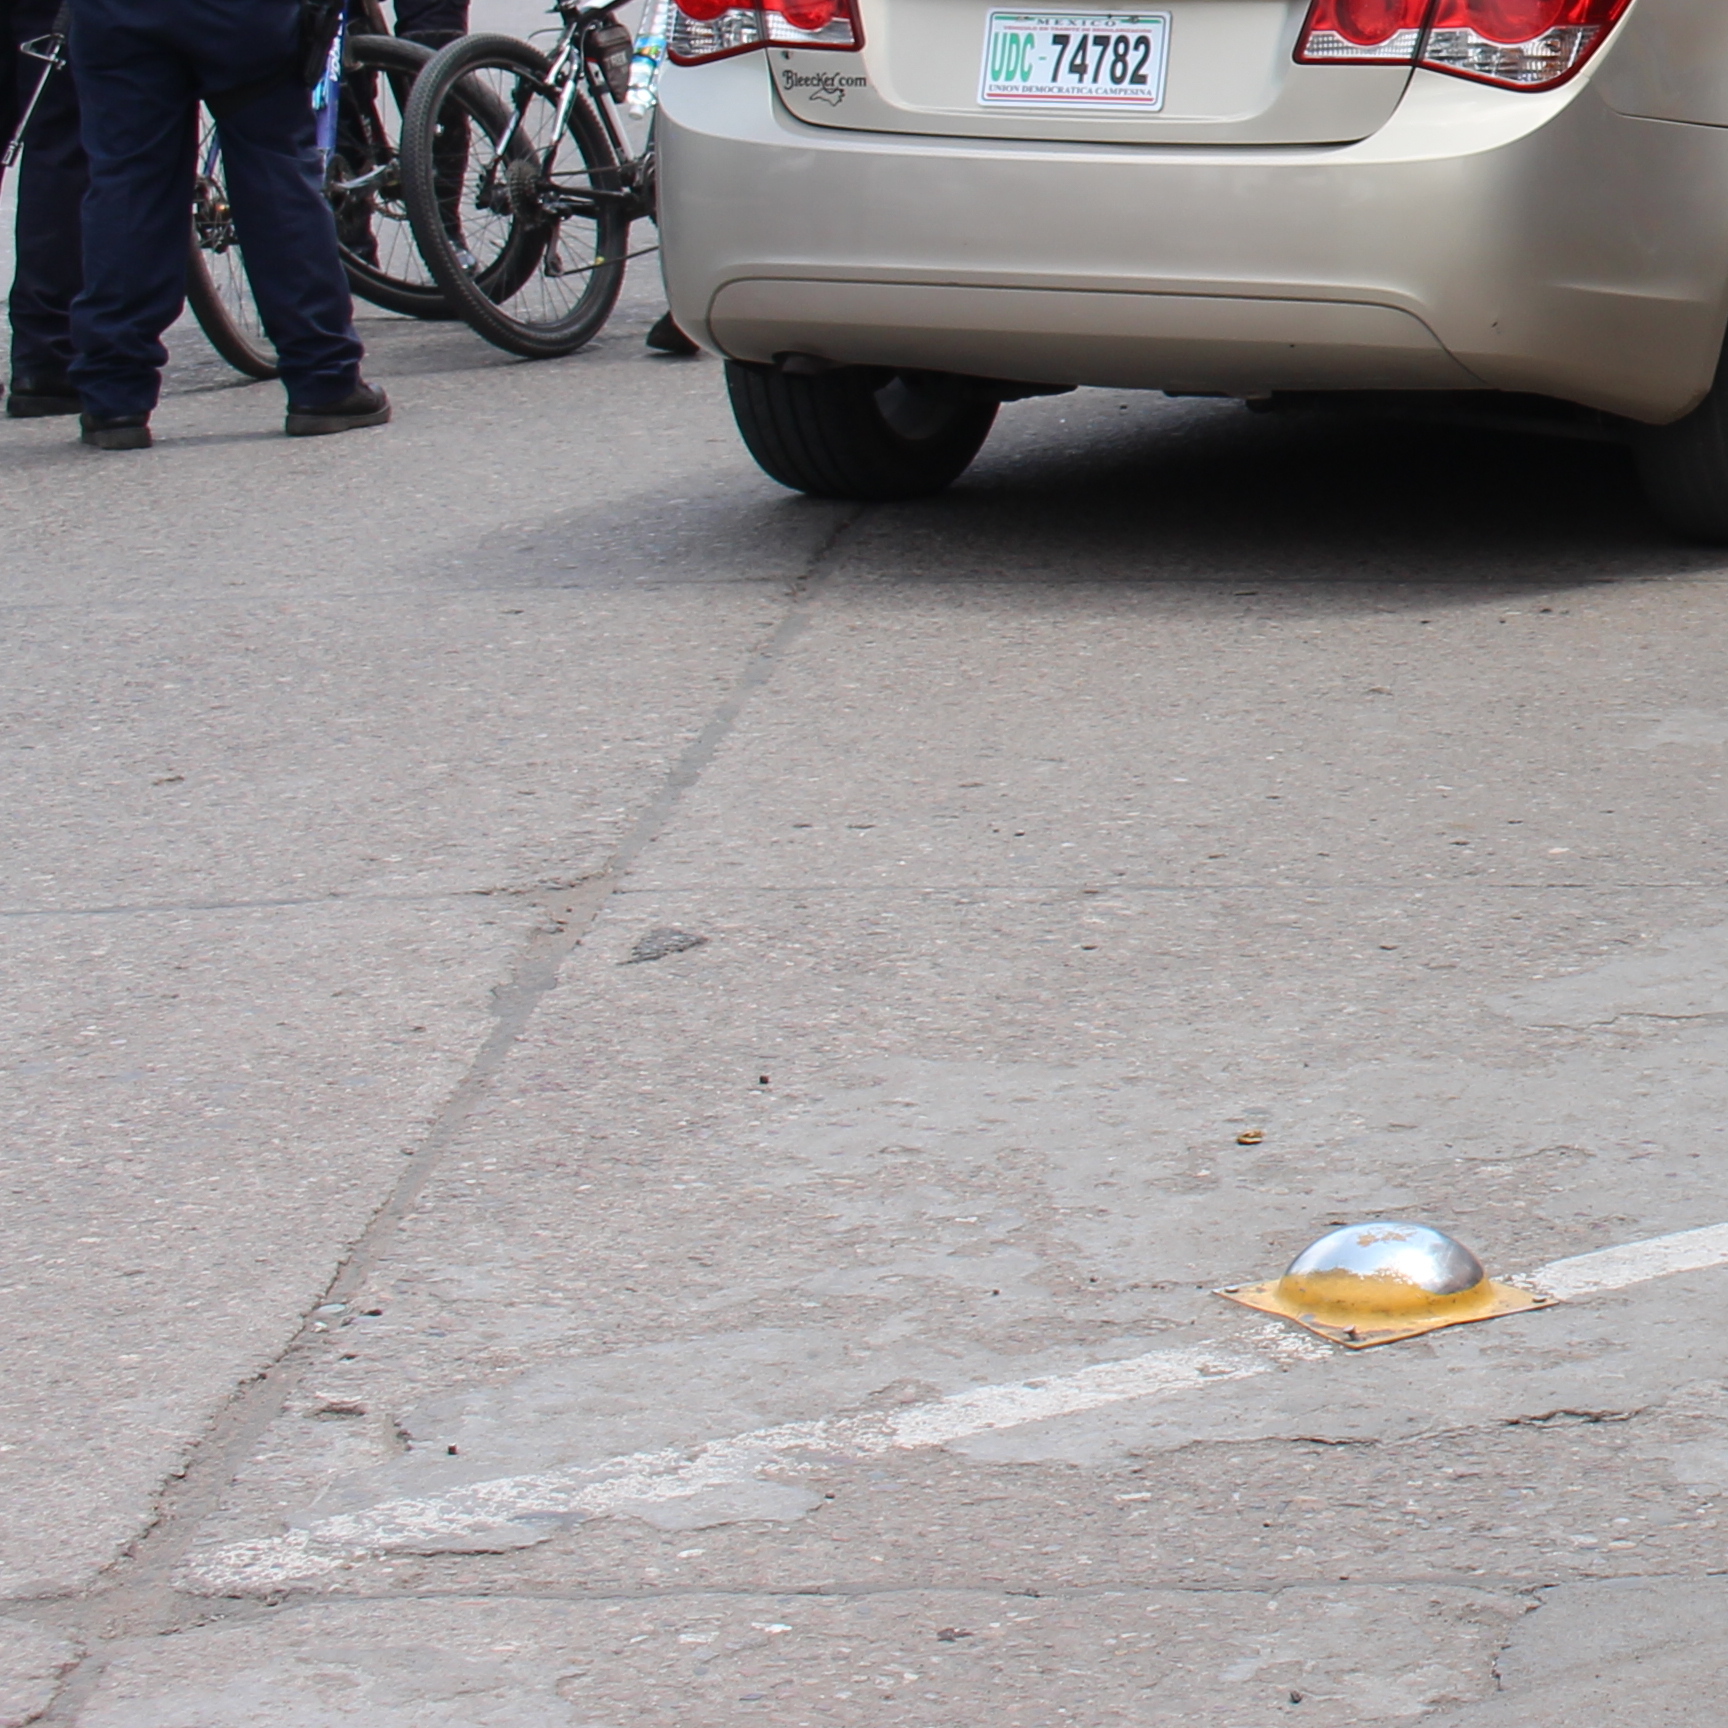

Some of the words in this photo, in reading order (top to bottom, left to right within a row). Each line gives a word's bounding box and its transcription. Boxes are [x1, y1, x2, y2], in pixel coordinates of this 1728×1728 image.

[1036, 18, 1117, 27] MEXICO
[988, 83, 1020, 93] UNION
[1021, 85, 1094, 95] DEMOCRATICA
[1095, 86, 1153, 97] CAMPESINA
